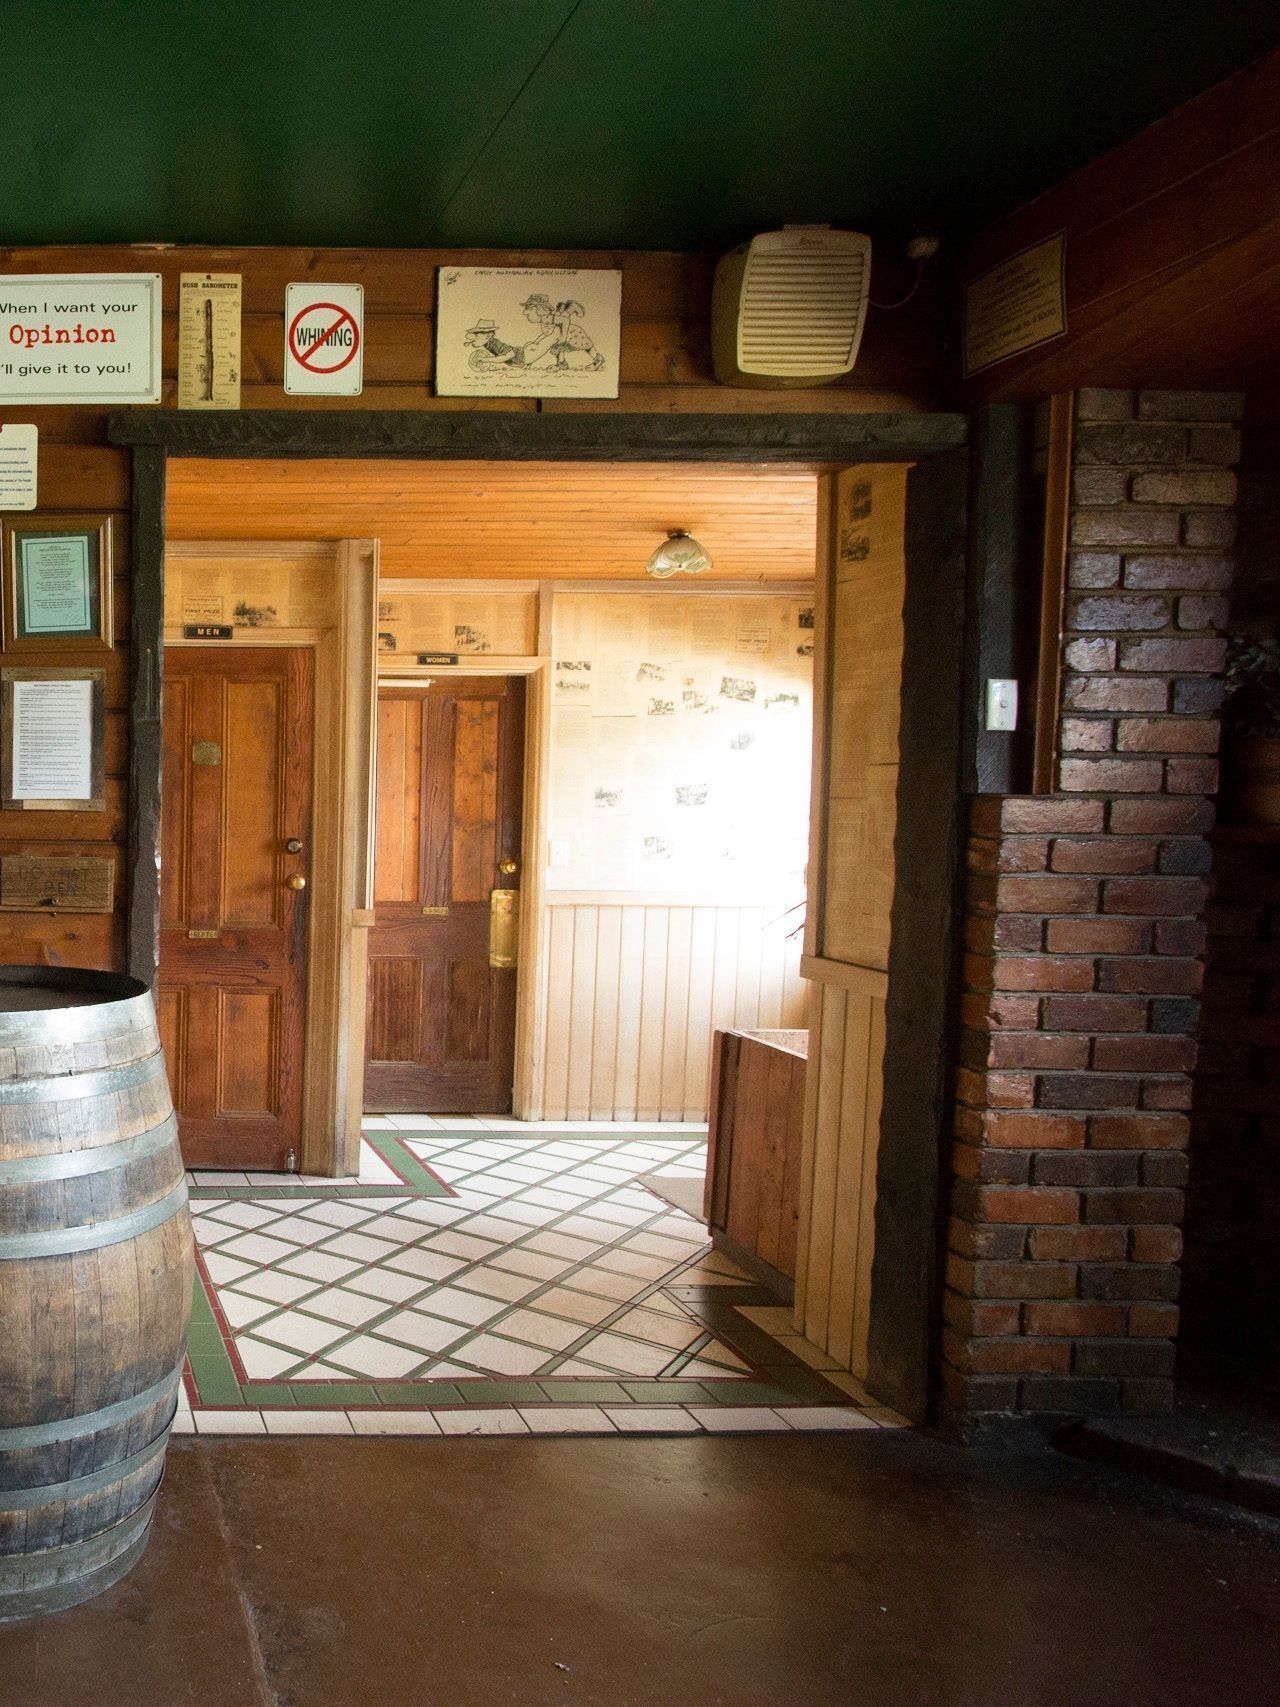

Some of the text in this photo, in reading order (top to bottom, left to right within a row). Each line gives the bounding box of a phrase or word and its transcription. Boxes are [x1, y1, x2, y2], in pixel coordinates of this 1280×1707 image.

[44, 303, 47, 312] I
[54, 304, 95, 313] want
[102, 303, 138, 314] your
[10, 324, 116, 348] Opinion
[19, 364, 51, 376] give
[58, 364, 68, 373] it
[74, 364, 90, 373] to
[97, 363, 131, 375] you!
